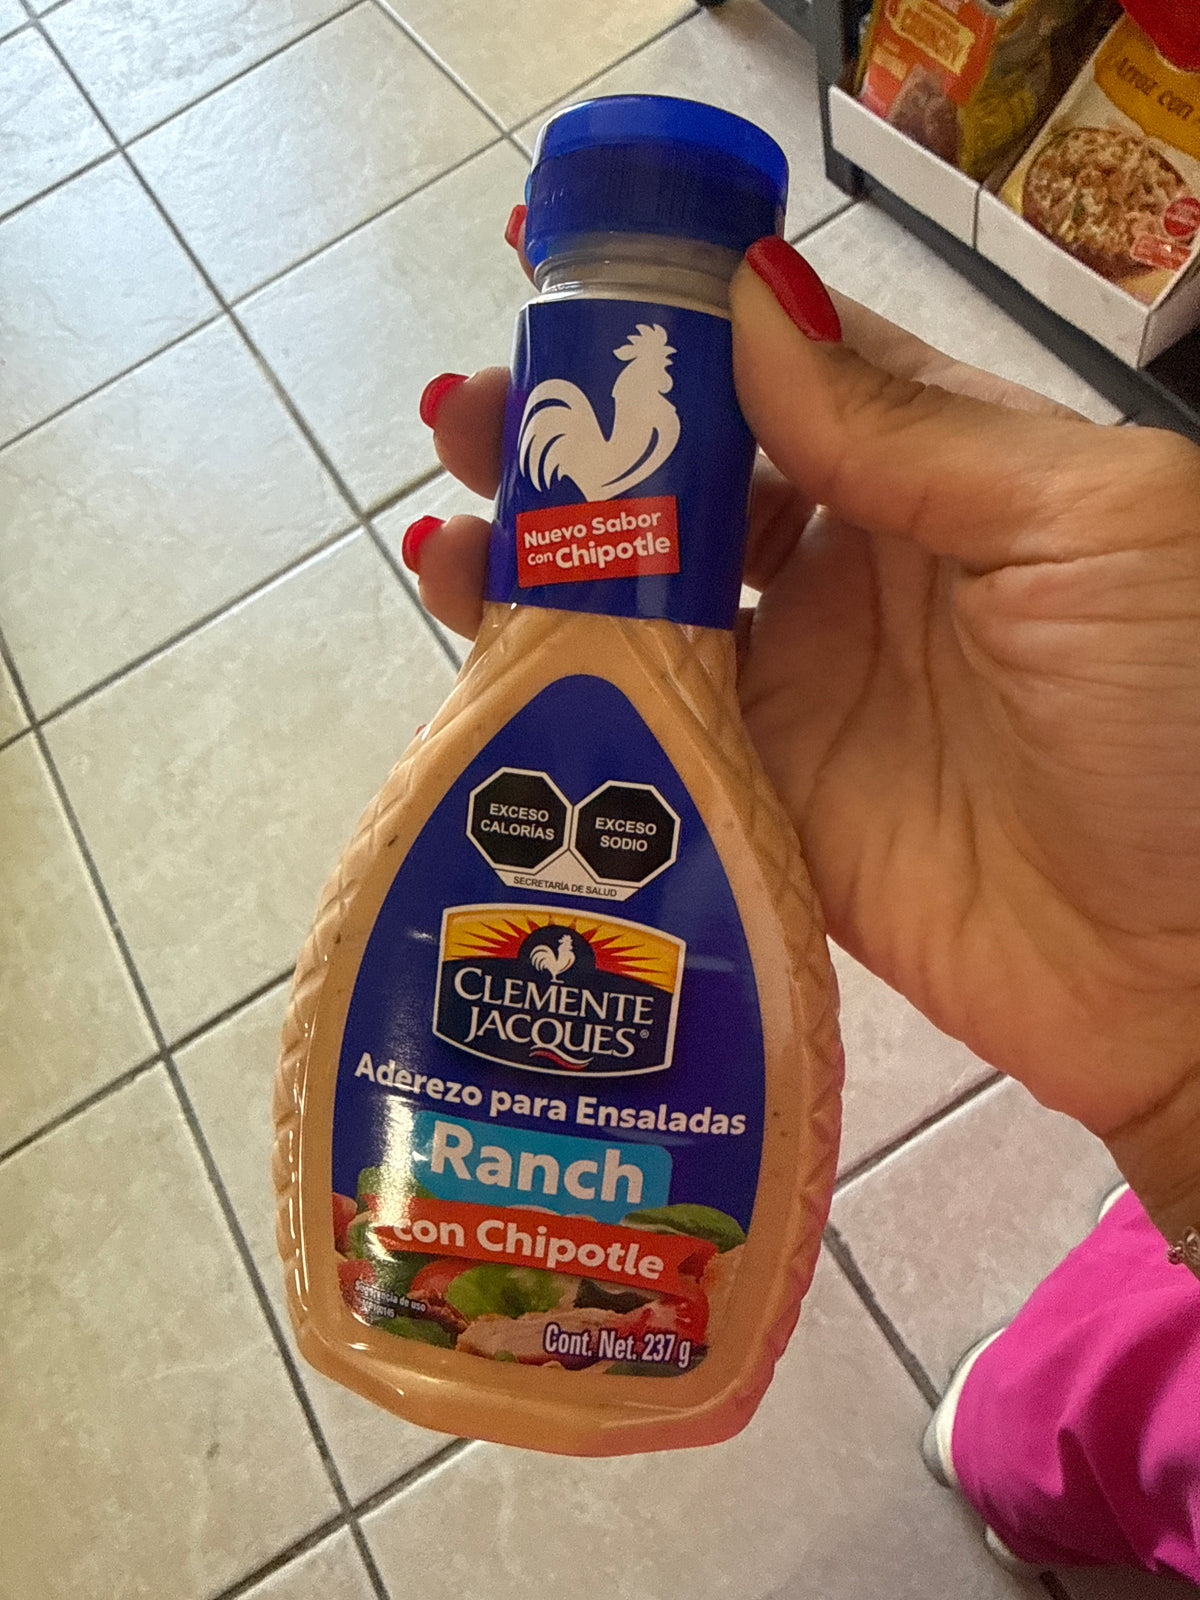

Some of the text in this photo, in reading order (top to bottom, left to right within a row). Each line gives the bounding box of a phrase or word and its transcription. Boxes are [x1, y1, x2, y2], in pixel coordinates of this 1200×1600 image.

[524, 512, 661, 549] Nuevo Sabor
[527, 532, 671, 569] Con Chipotle
[480, 818, 555, 841] CALORÍAS
[489, 803, 549, 822] EXCESO
[595, 817, 657, 836] EXCESO
[600, 835, 648, 852] SODIO
[513, 876, 617, 898] SECRETARÍA DE SALUD
[453, 966, 655, 1025] CLEMENTE
[354, 1051, 483, 1106] Aderezo
[489, 1089, 747, 1136] para Ensaladas
[429, 1119, 646, 1204] Ranch
[393, 1218, 665, 1281] con Chipotle
[399, 1296, 410, 1307] de
[410, 1301, 426, 1312] uso
[544, 1324, 691, 1369] Cont. Net. 237 g
